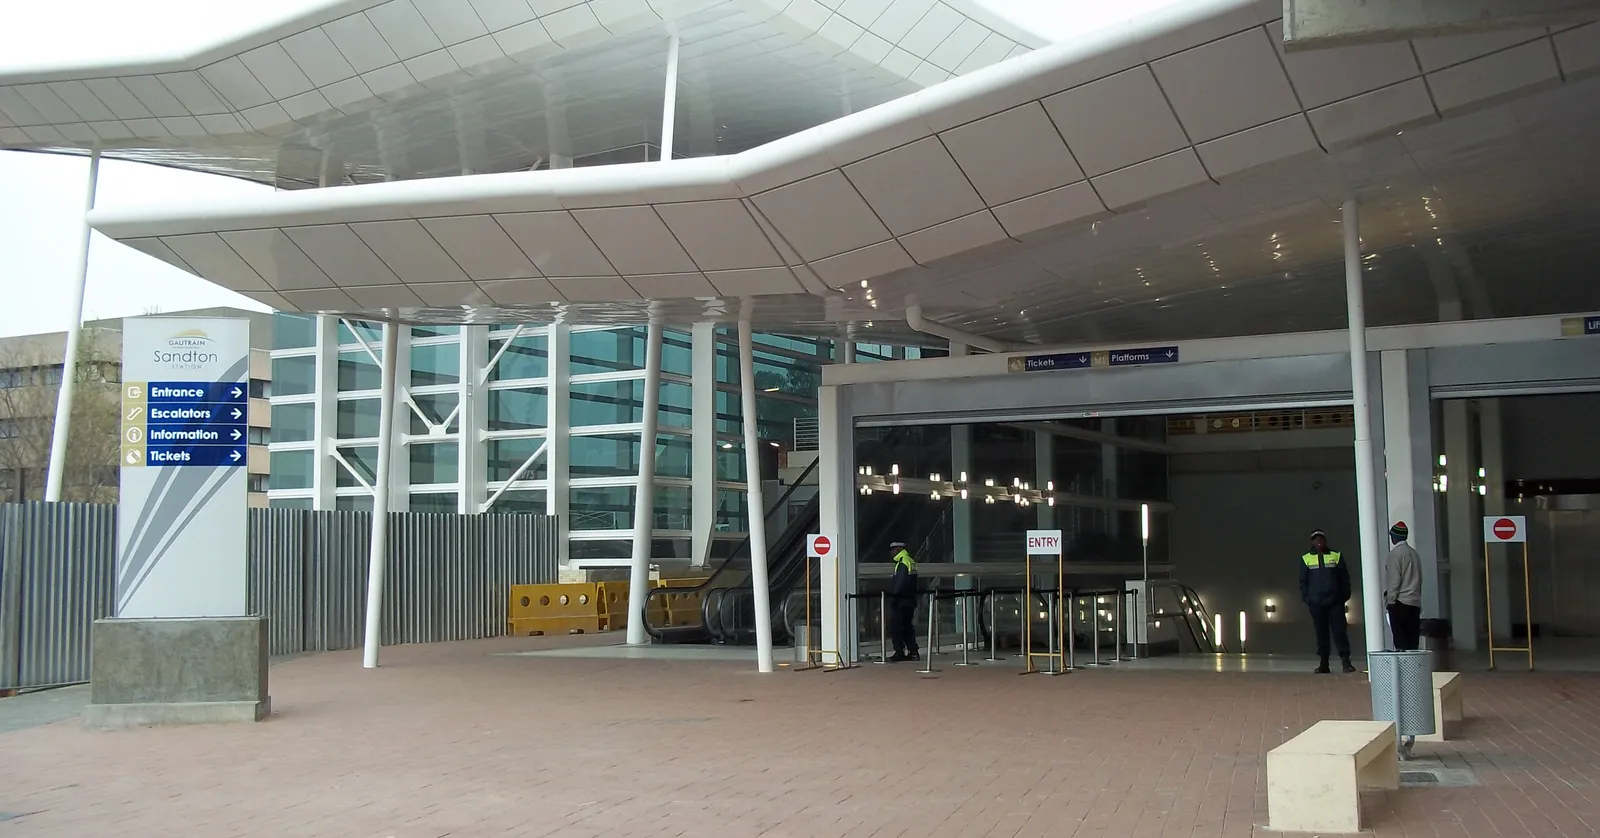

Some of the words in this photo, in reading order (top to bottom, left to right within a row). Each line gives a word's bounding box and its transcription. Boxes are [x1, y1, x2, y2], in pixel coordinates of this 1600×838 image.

[153, 350, 218, 363] Sandton
[1111, 353, 1150, 362] Platforms
[1027, 359, 1055, 368] Tickets
[151, 387, 204, 398] Entrance
[151, 408, 211, 419] Escalators
[150, 429, 218, 440] Information
[150, 450, 191, 461] Tickets
[1028, 537, 1059, 548] ENTRY
